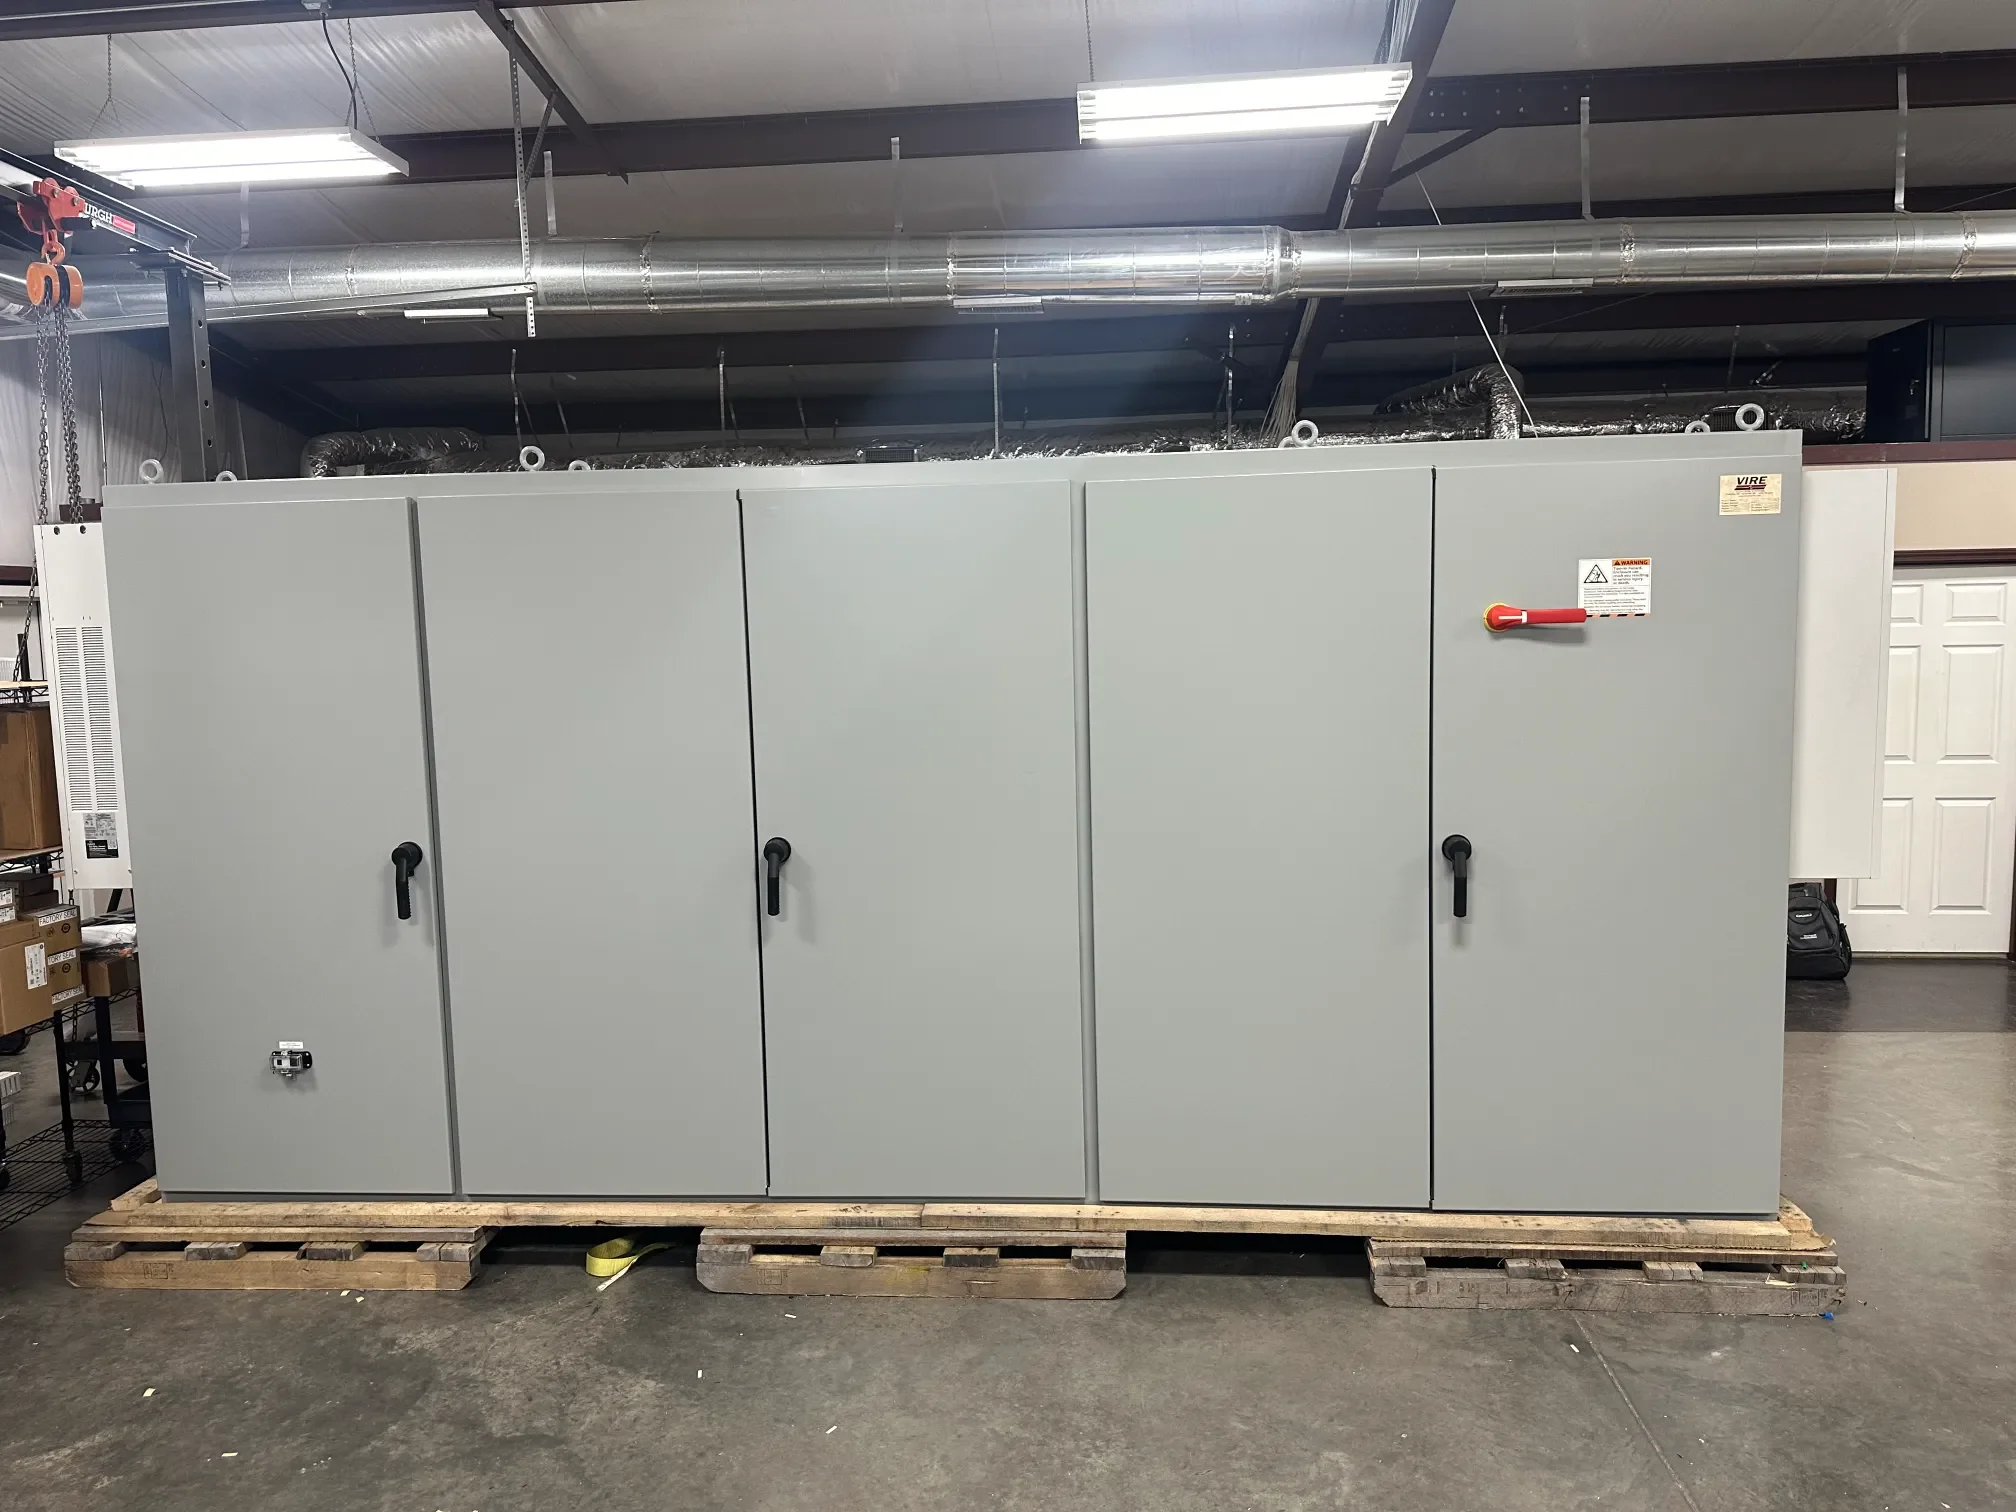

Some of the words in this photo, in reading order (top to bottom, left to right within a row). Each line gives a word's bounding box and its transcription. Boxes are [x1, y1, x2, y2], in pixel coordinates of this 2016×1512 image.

[1737, 476, 1767, 485] VIRE
[40, 911, 62, 925] FACTORY
[63, 908, 77, 919] SEAL
[63, 951, 75, 960] SEAL
[52, 988, 72, 1003] FACTORY
